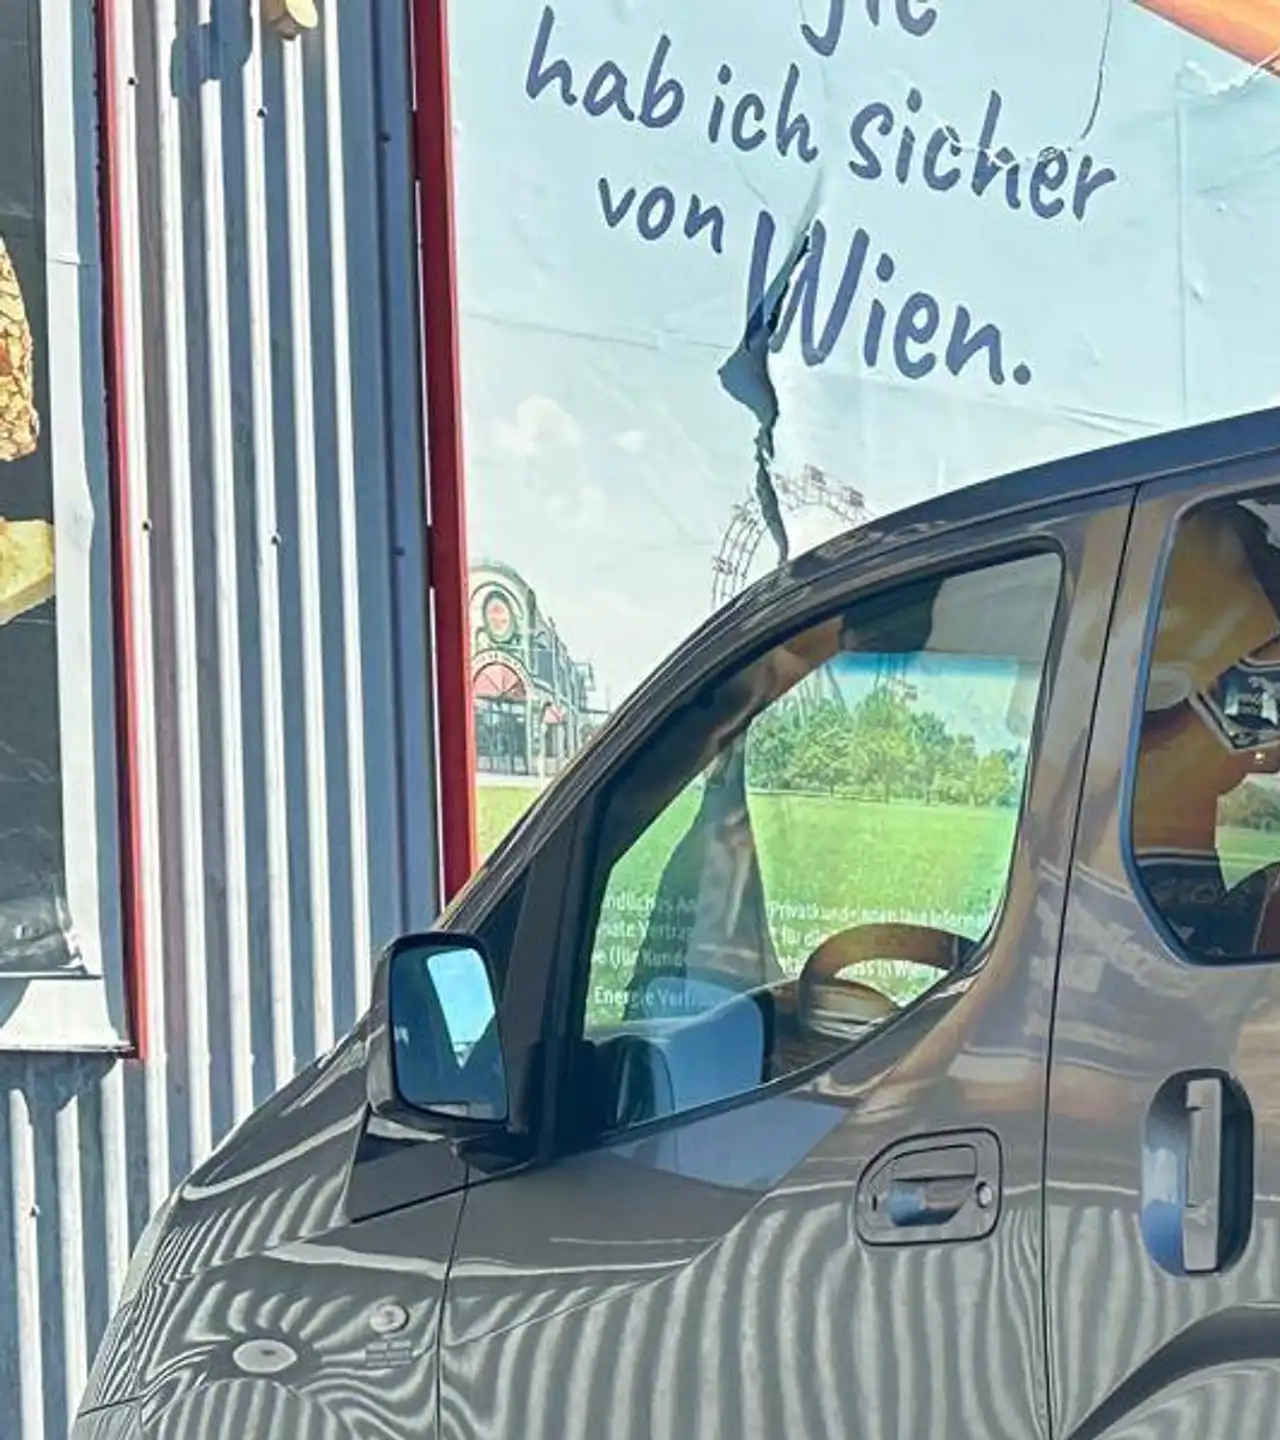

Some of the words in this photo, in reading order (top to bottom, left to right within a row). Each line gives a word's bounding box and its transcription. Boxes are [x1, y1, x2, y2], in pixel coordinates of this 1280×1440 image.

[525, 6, 685, 127] hab
[708, 64, 818, 162] ich
[849, 89, 1117, 220] sicher
[598, 177, 725, 254] von
[742, 210, 1032, 386] Wien.
